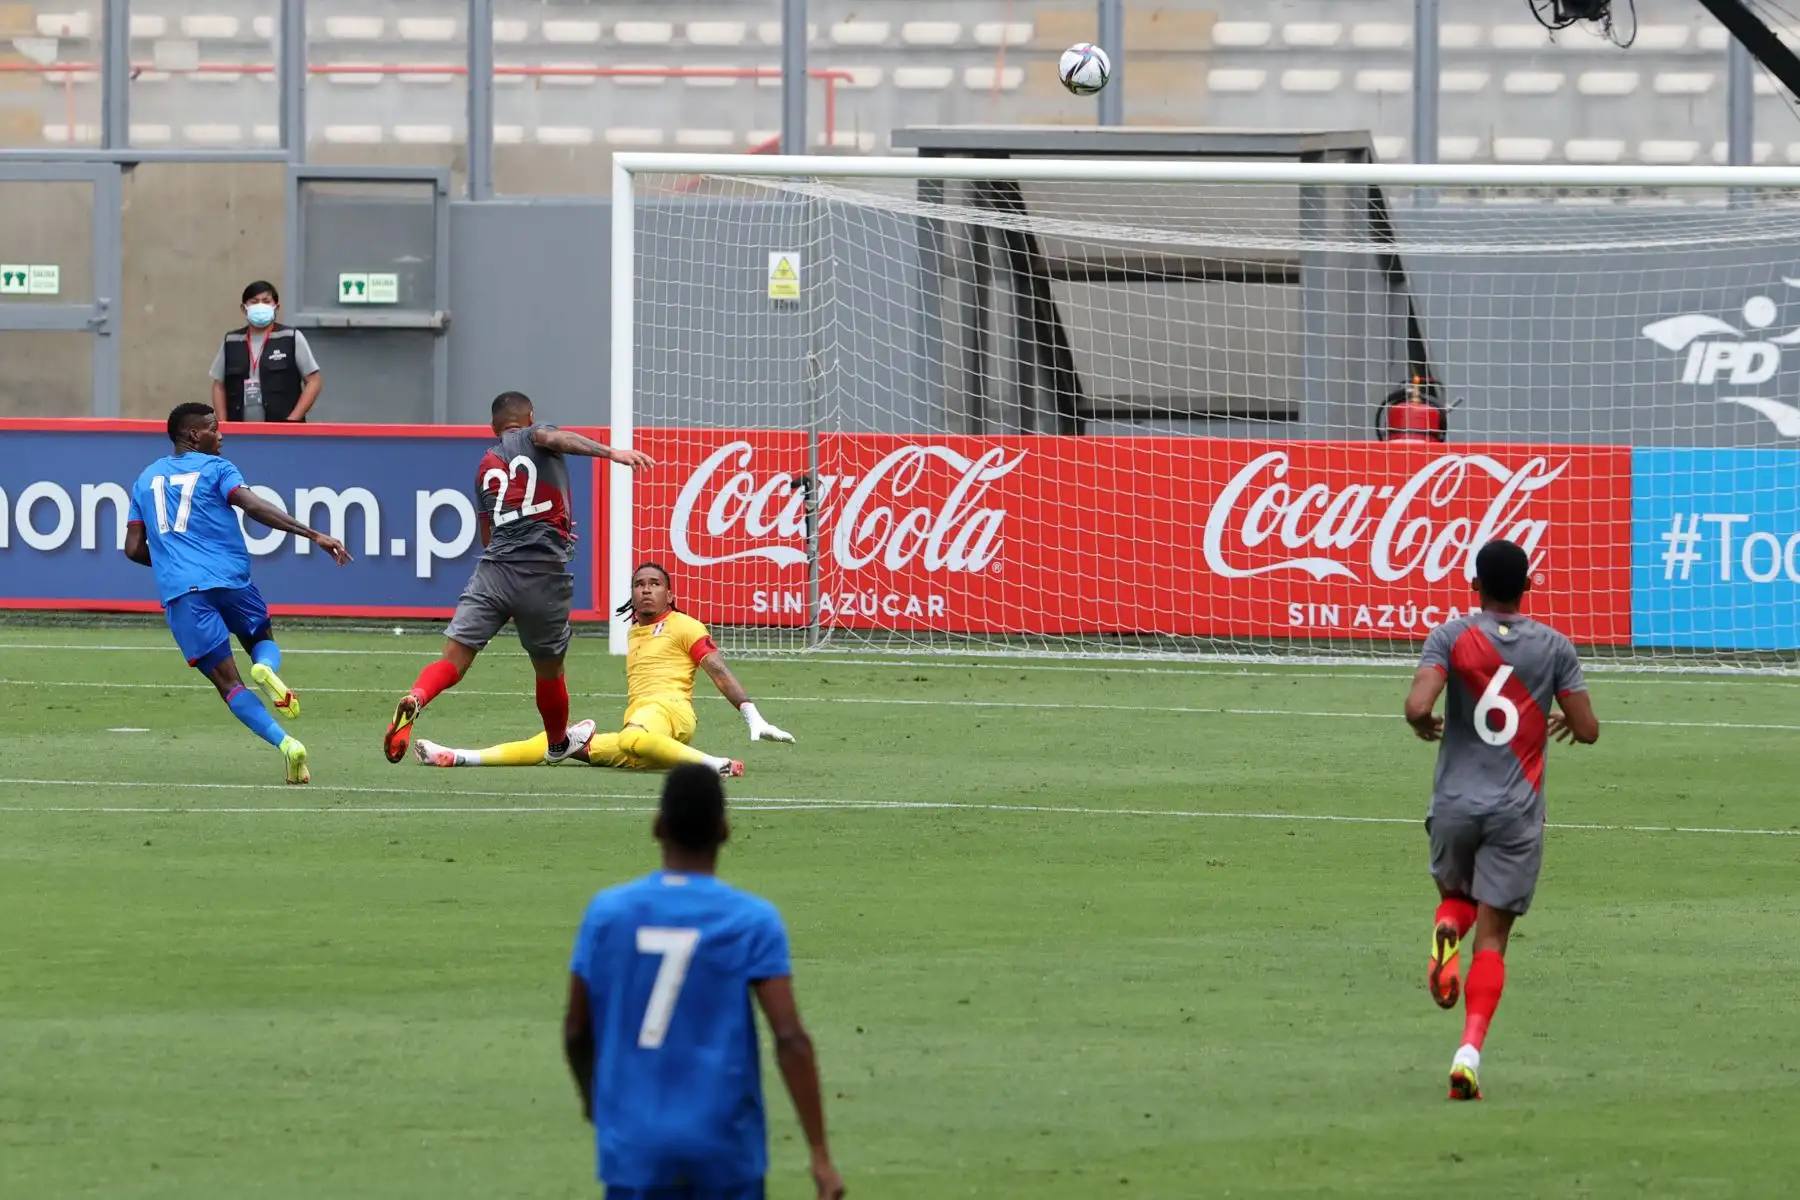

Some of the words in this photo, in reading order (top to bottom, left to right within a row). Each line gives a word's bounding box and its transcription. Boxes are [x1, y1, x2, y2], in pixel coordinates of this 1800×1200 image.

[1681, 341, 1781, 385] IPD
[150, 471, 200, 534] 17
[483, 455, 552, 526] 22
[670, 441, 1028, 572] Coca-Cola
[752, 591, 802, 614] SIN
[818, 588, 945, 617] AZÚCAR
[1287, 603, 1339, 627] SIN
[1474, 664, 1519, 746] 6
[635, 926, 700, 1049] 7
